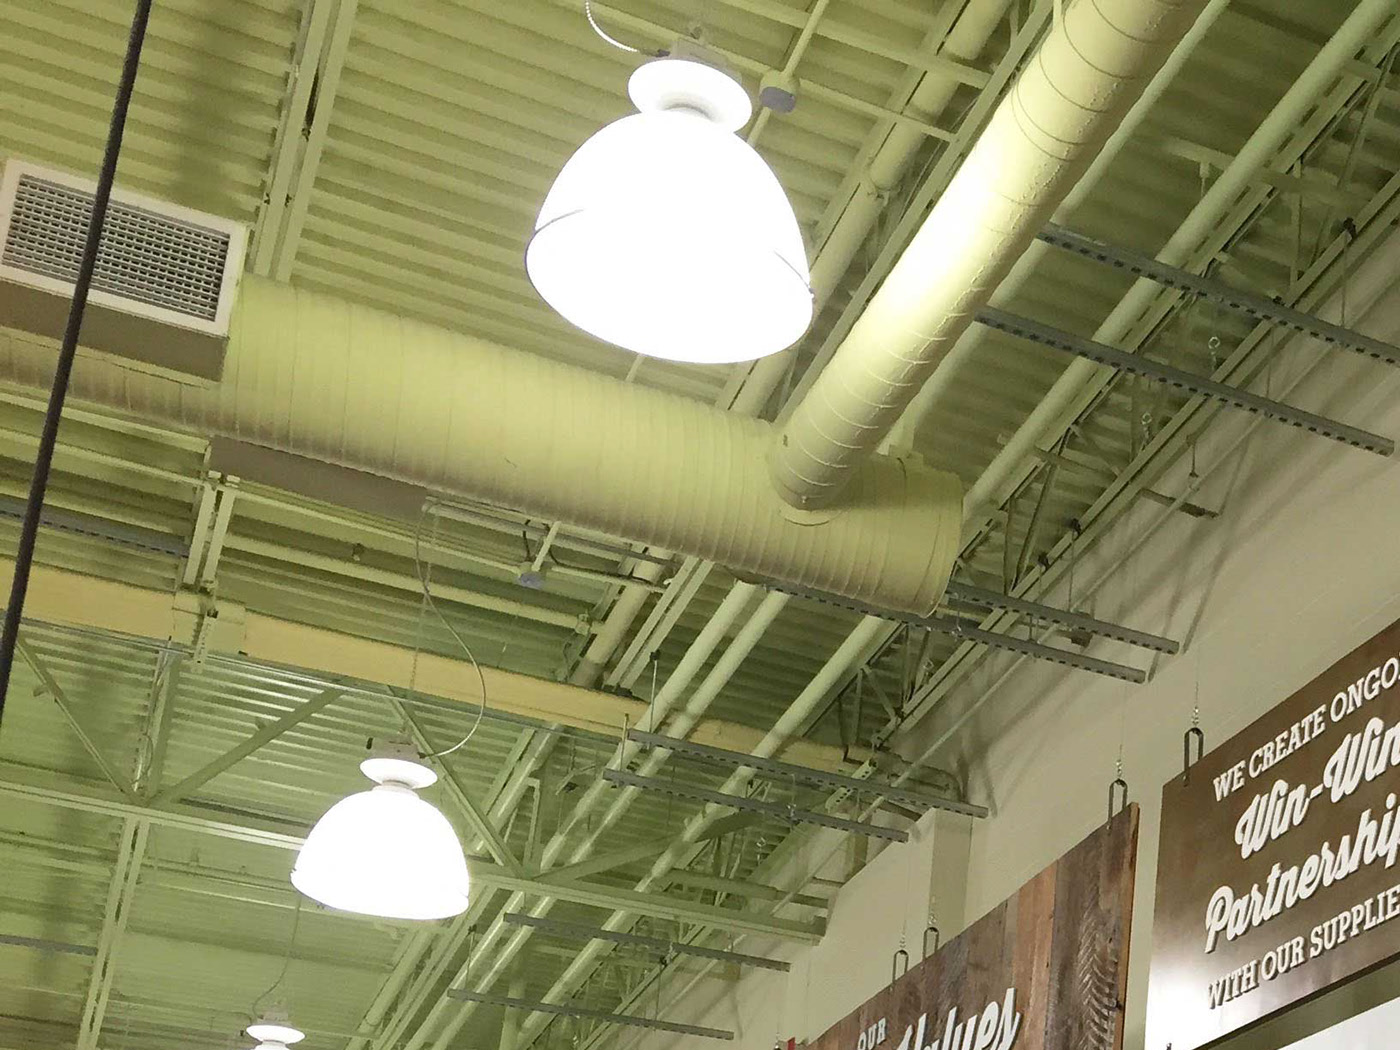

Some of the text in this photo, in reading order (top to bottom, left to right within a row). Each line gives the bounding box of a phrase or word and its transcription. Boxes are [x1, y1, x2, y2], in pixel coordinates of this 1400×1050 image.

[1212, 765, 1245, 802] WE
[1249, 704, 1327, 776] CREATE
[1207, 958, 1258, 1009] WITH
[1261, 936, 1305, 981] OUR
